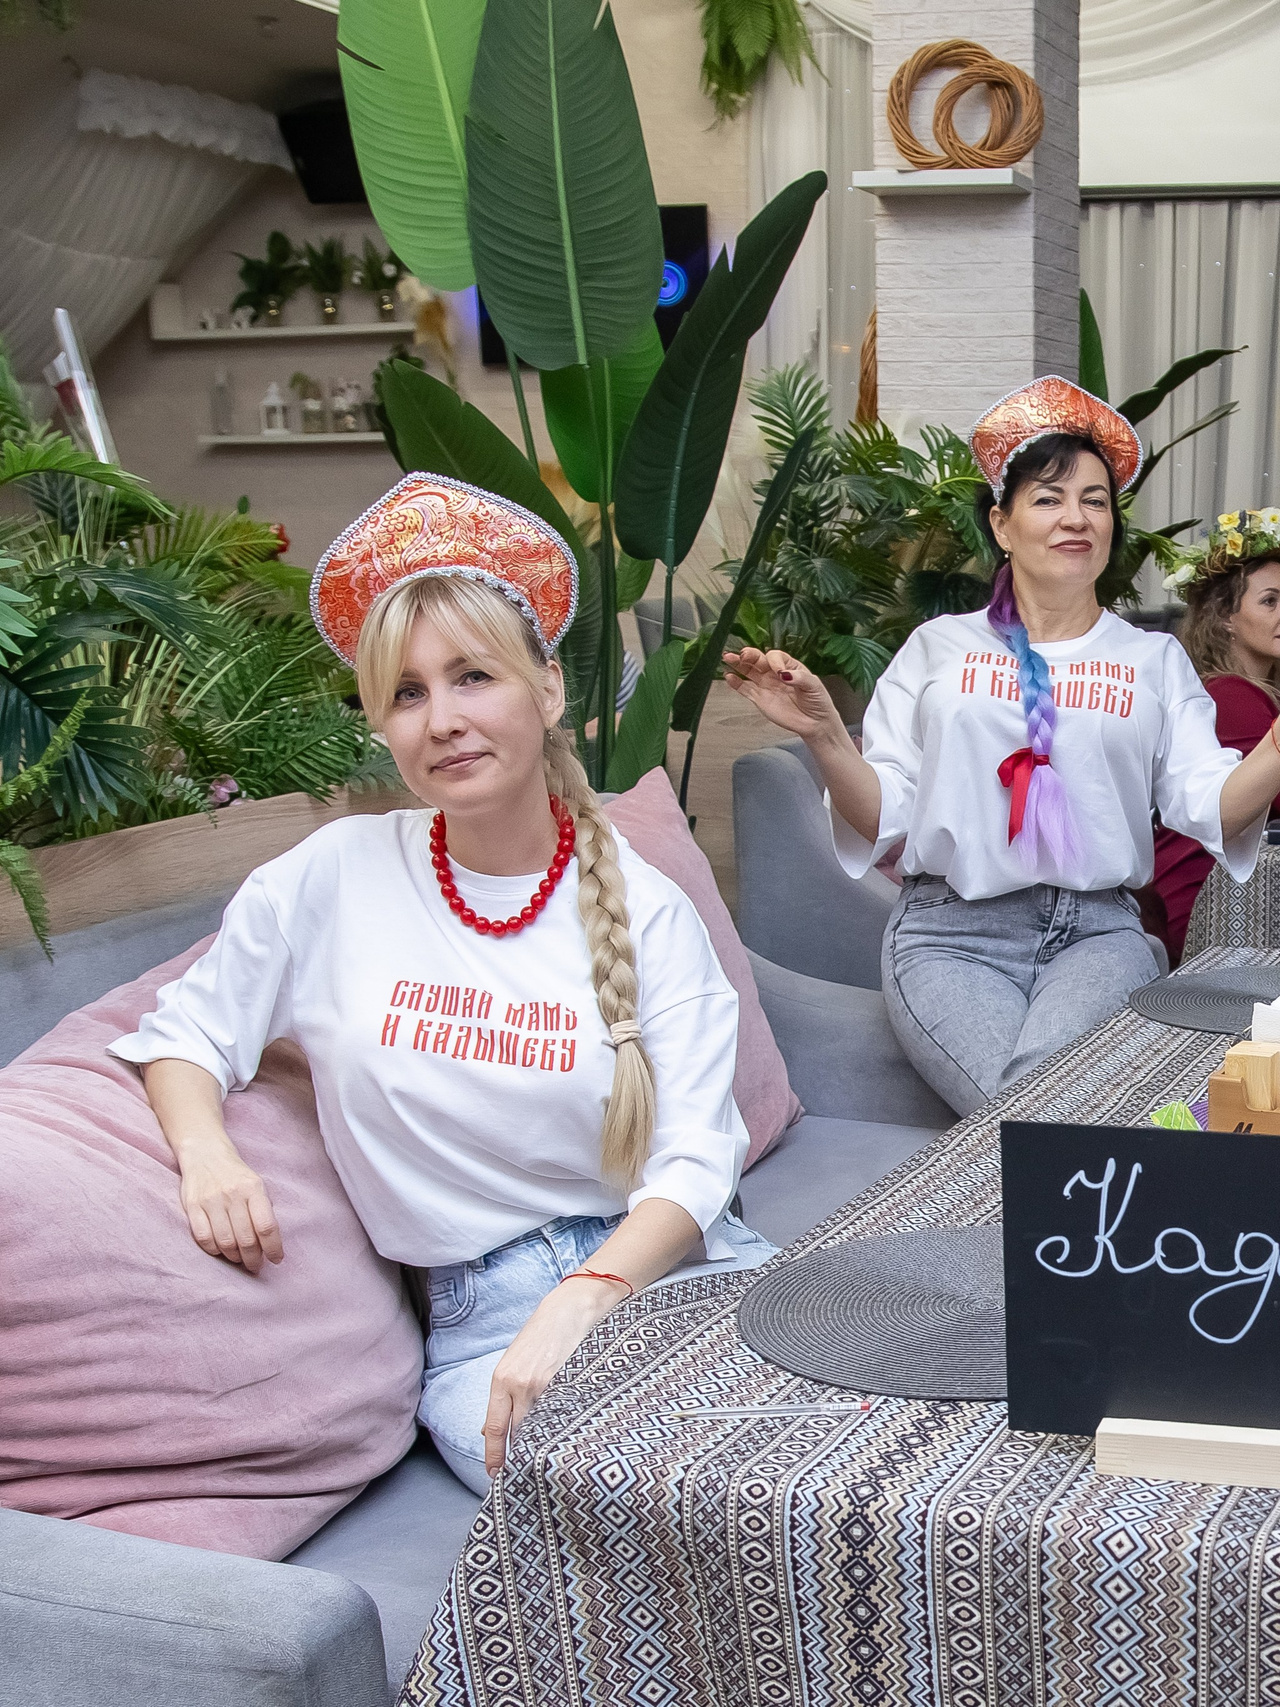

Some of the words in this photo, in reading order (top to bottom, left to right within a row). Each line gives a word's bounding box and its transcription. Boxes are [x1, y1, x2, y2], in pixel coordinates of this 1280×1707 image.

[961, 667, 977, 694] И
[1069, 661, 1135, 684] МАМУ
[390, 979, 494, 1020] СЛУШАЙ
[380, 1013, 402, 1047] И
[412, 1018, 577, 1073] КАДЫШЕВУ
